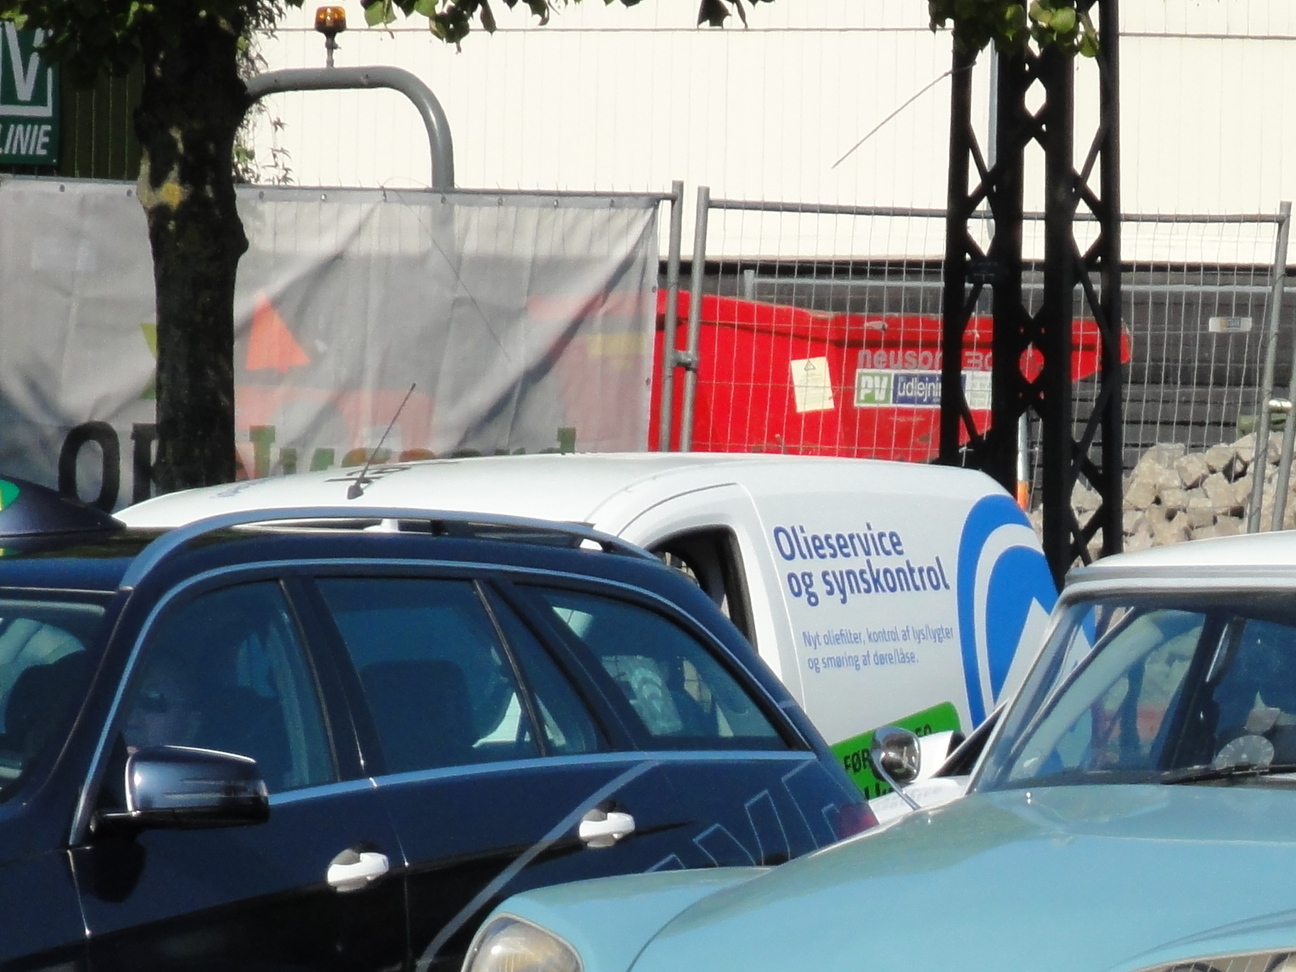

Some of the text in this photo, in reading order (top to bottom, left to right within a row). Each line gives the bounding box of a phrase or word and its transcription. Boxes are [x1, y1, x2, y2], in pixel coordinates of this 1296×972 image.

[860, 376, 888, 401] PV
[773, 521, 904, 561] Olieservice
[787, 555, 950, 607] og synskontrol
[802, 624, 954, 650] Nyt oliefilter, kontrol af lys/lygter
[807, 657, 820, 673] og
[822, 652, 860, 671] smøring
[862, 651, 871, 666] af
